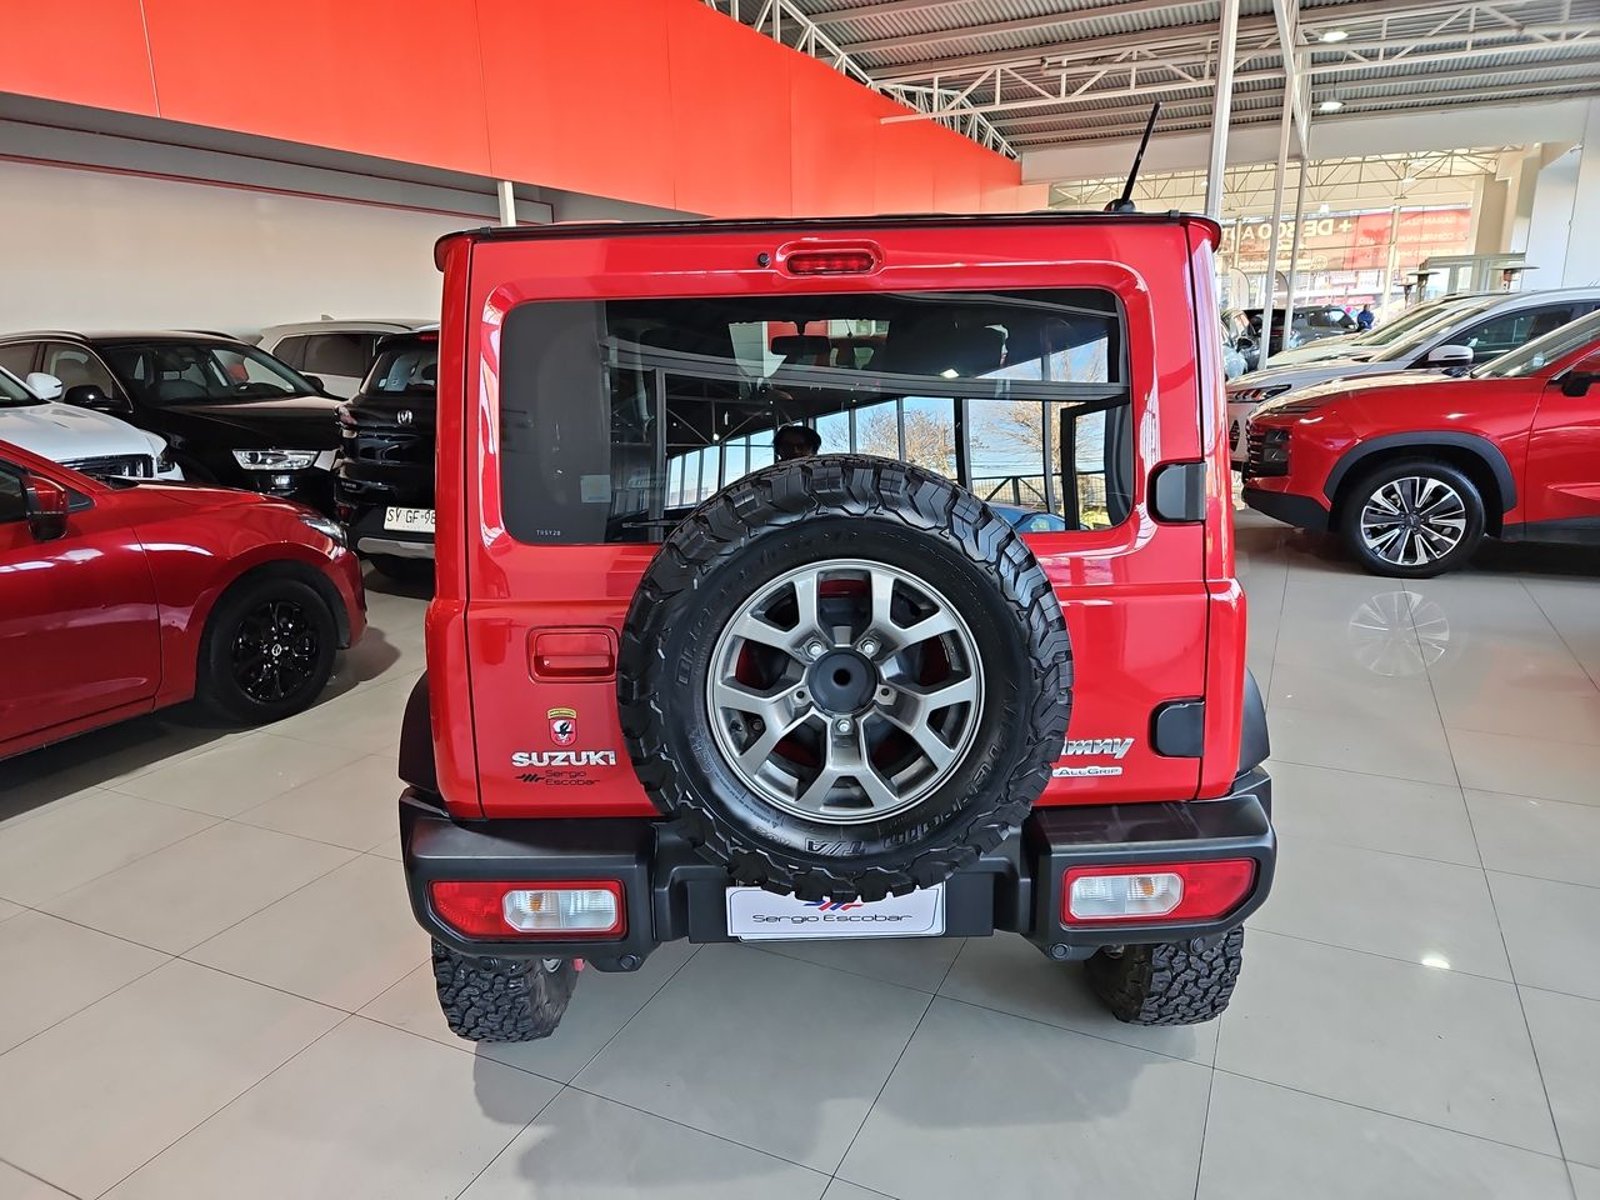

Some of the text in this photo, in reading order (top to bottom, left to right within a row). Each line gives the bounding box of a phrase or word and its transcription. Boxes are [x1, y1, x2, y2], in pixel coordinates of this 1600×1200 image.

[511, 750, 617, 767] SUZUKI
[545, 778, 601, 786] Escobar
[752, 914, 913, 924] Sergio Escobar
